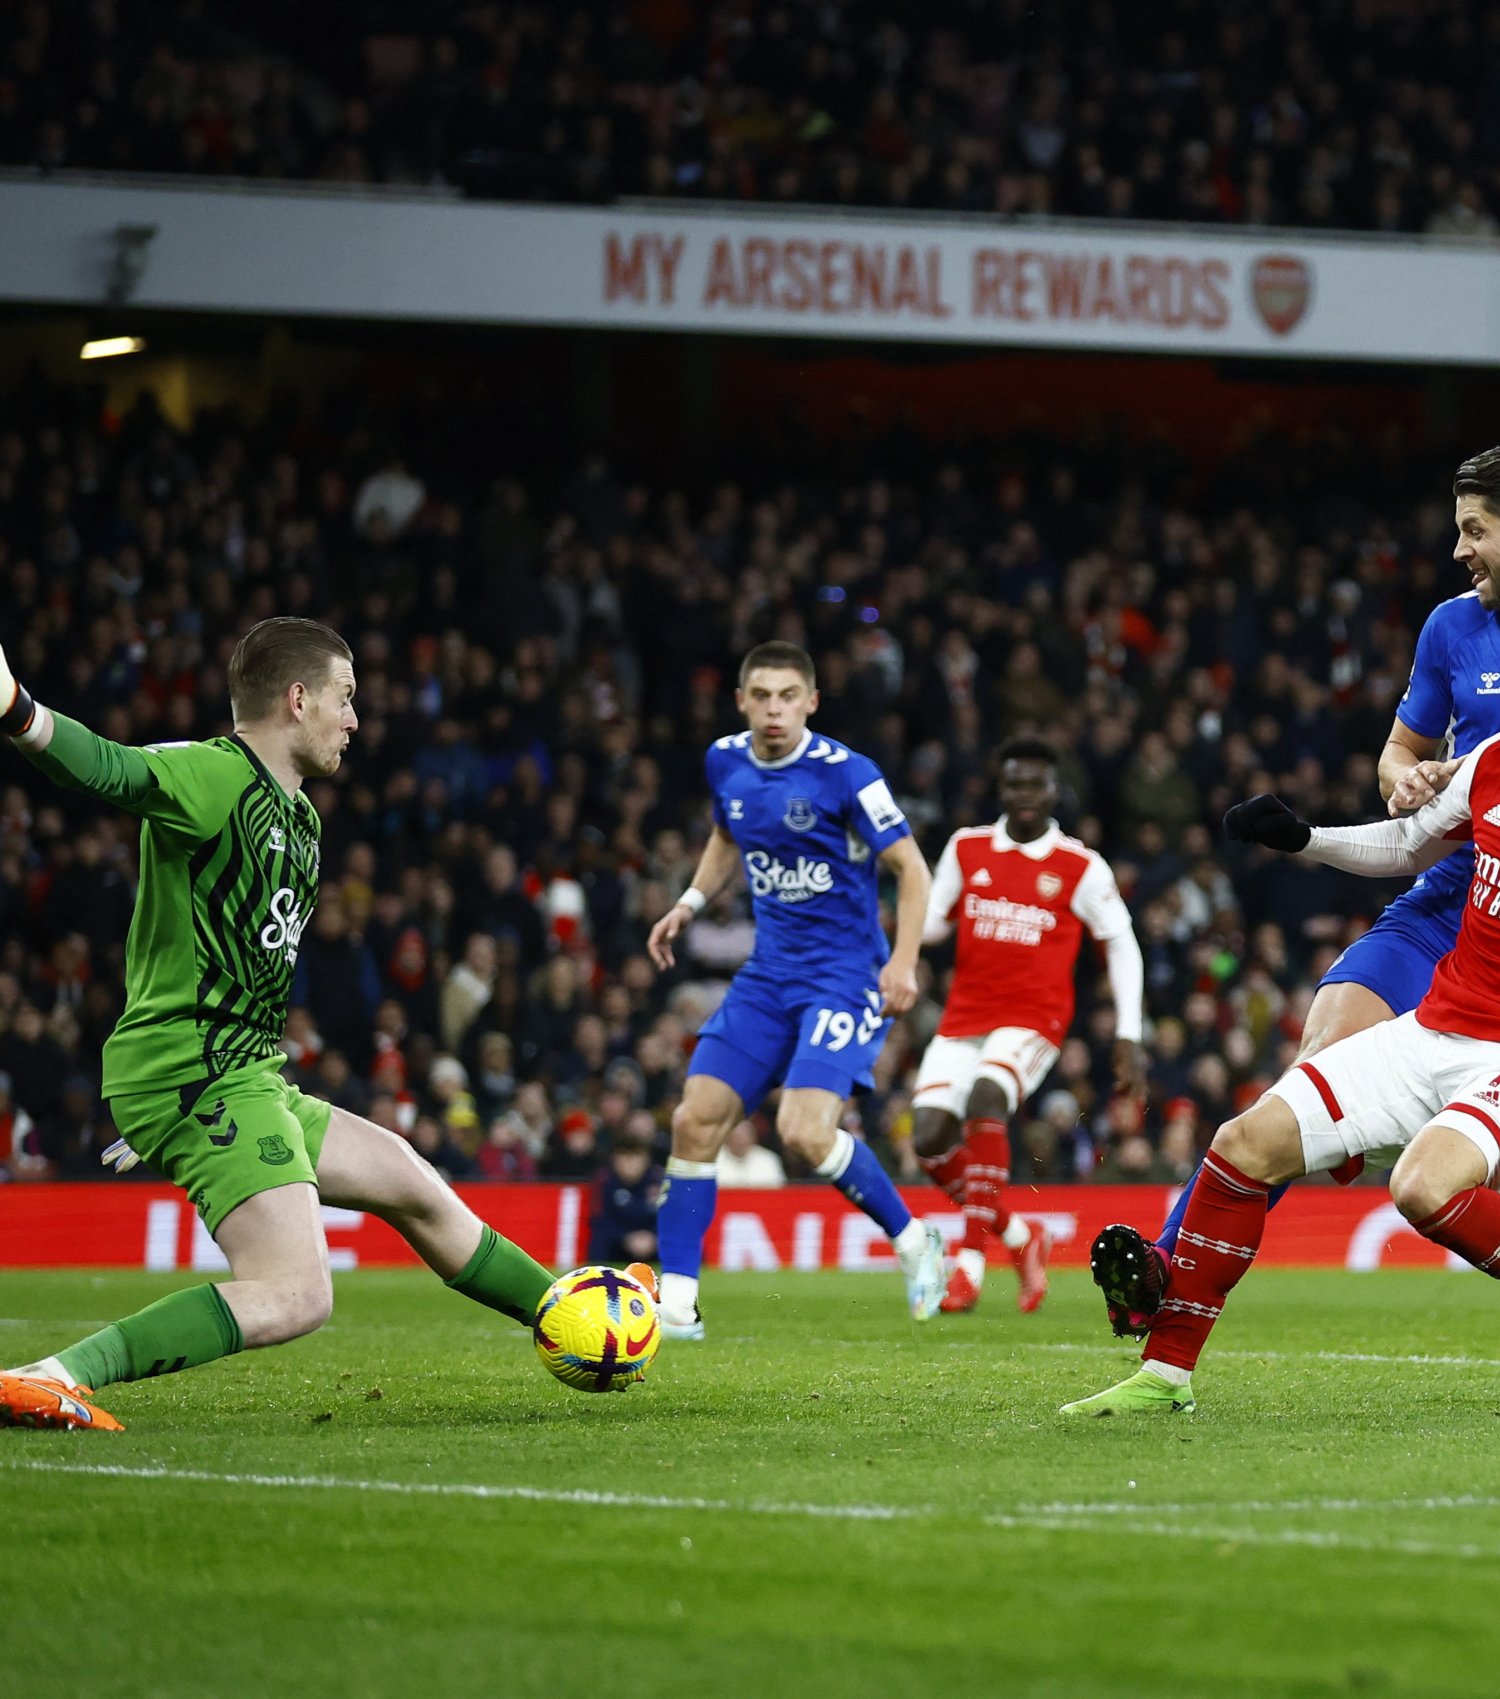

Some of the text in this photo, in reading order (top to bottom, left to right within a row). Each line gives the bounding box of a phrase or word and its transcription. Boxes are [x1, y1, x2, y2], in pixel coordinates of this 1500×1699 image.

[604, 231, 1230, 331] MY ARSENAL REWARDS
[745, 850, 834, 898] Stake
[810, 1007, 855, 1053] 19
